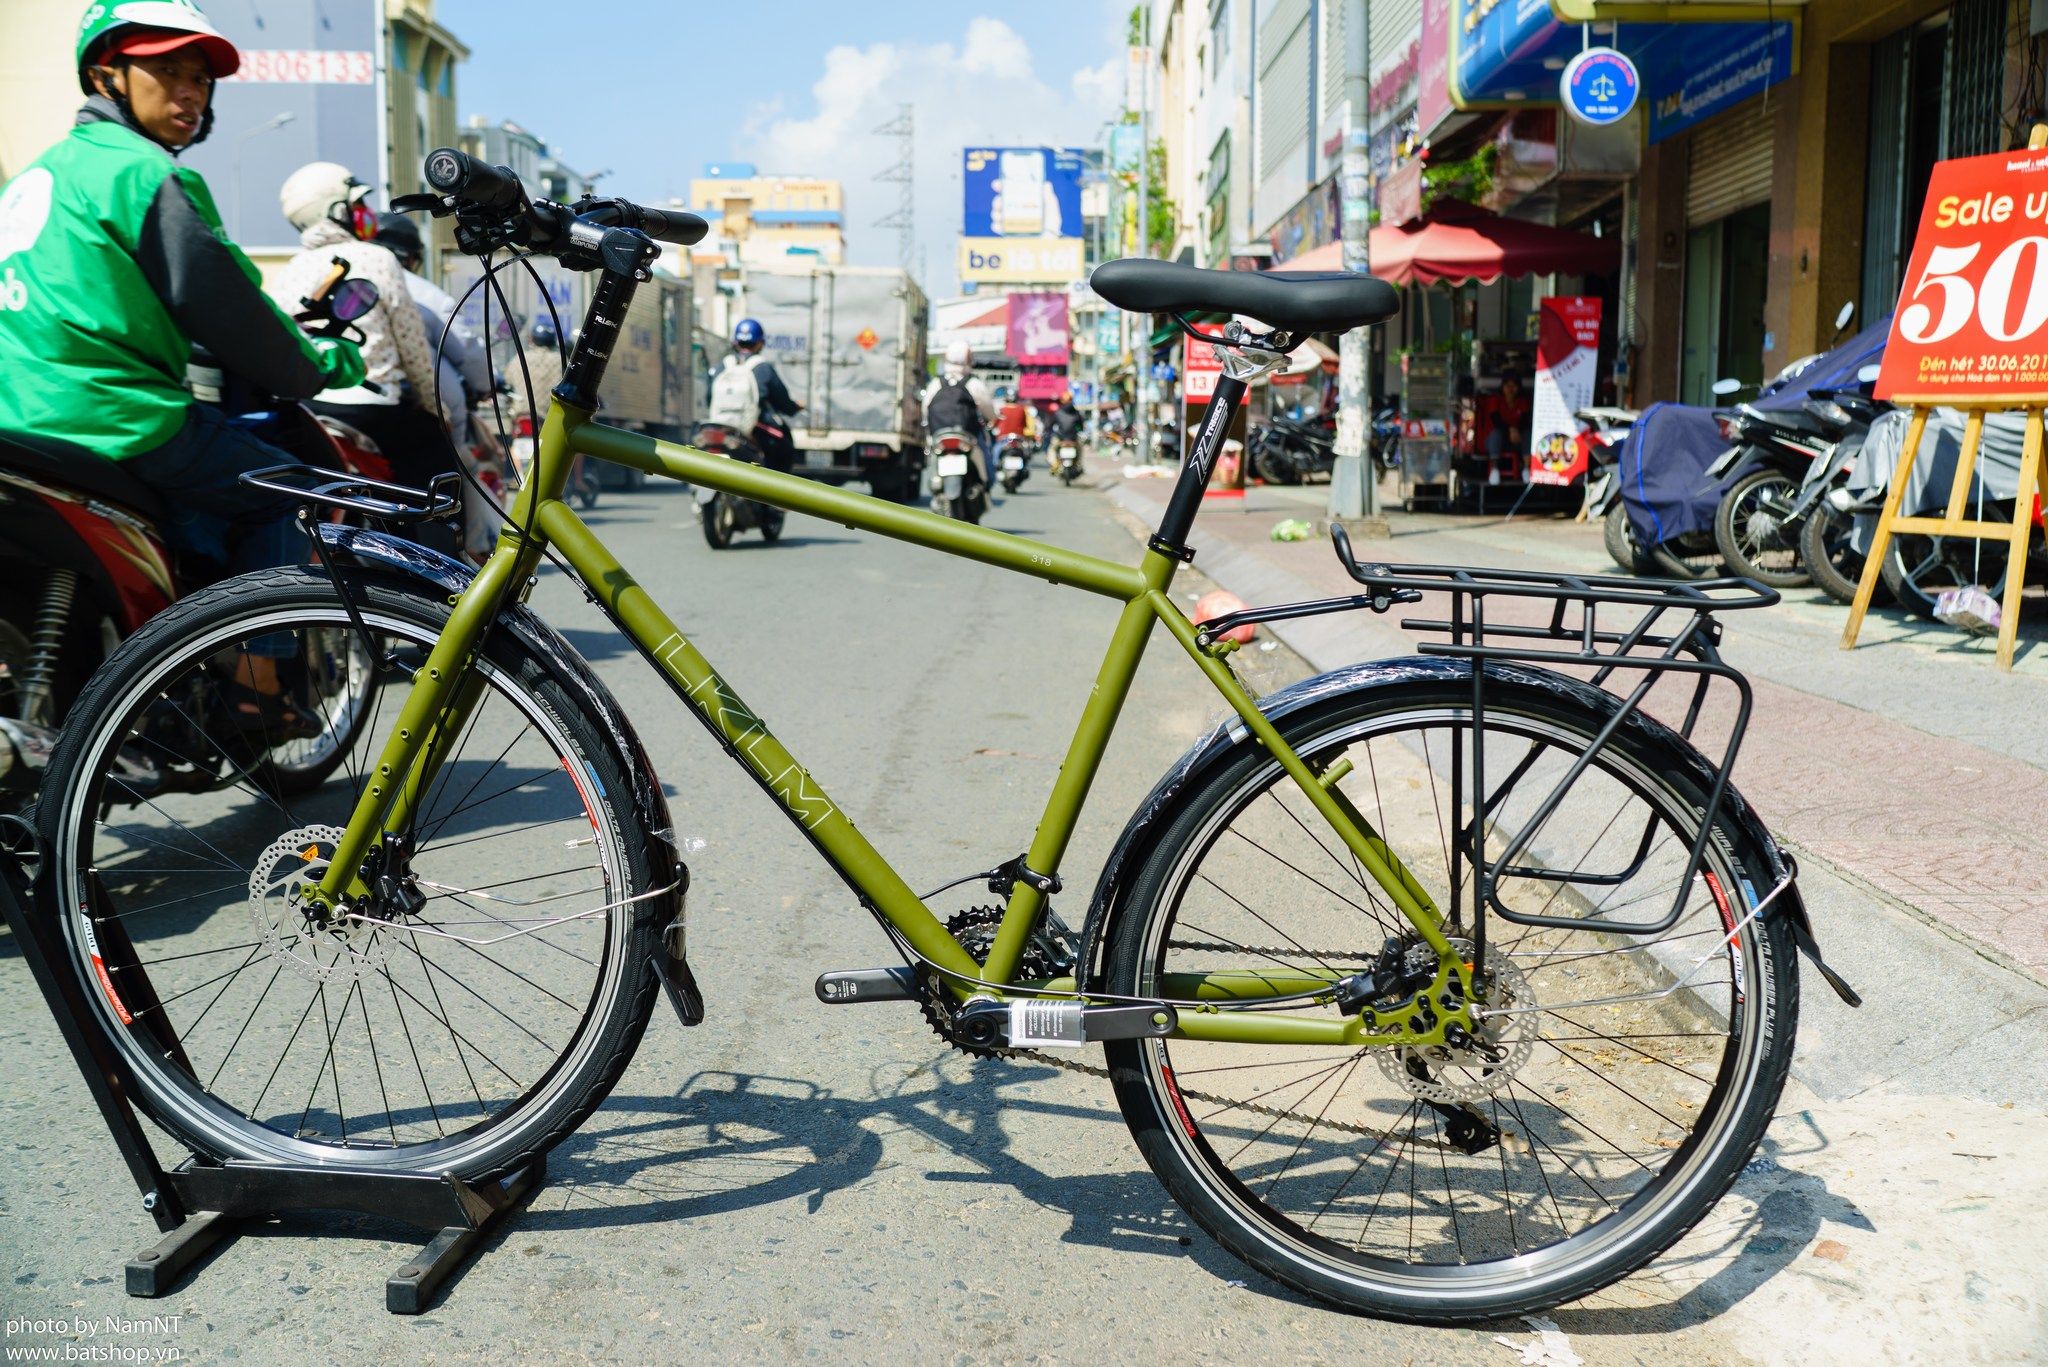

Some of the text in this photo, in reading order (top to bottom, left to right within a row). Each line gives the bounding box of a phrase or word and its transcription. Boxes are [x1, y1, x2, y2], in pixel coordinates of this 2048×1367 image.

[1935, 191, 2013, 229] Sale
[969, 250, 1001, 269] be
[1900, 235, 2048, 344] 50
[1031, 555, 1051, 567] 318
[534, 690, 586, 758] SCHWALBE
[604, 799, 621, 836] DELTA
[615, 837, 633, 882] CRUISER
[1695, 806, 1748, 876] SWALBE
[1757, 921, 1777, 1038] DELTA CRUISER PLUS
